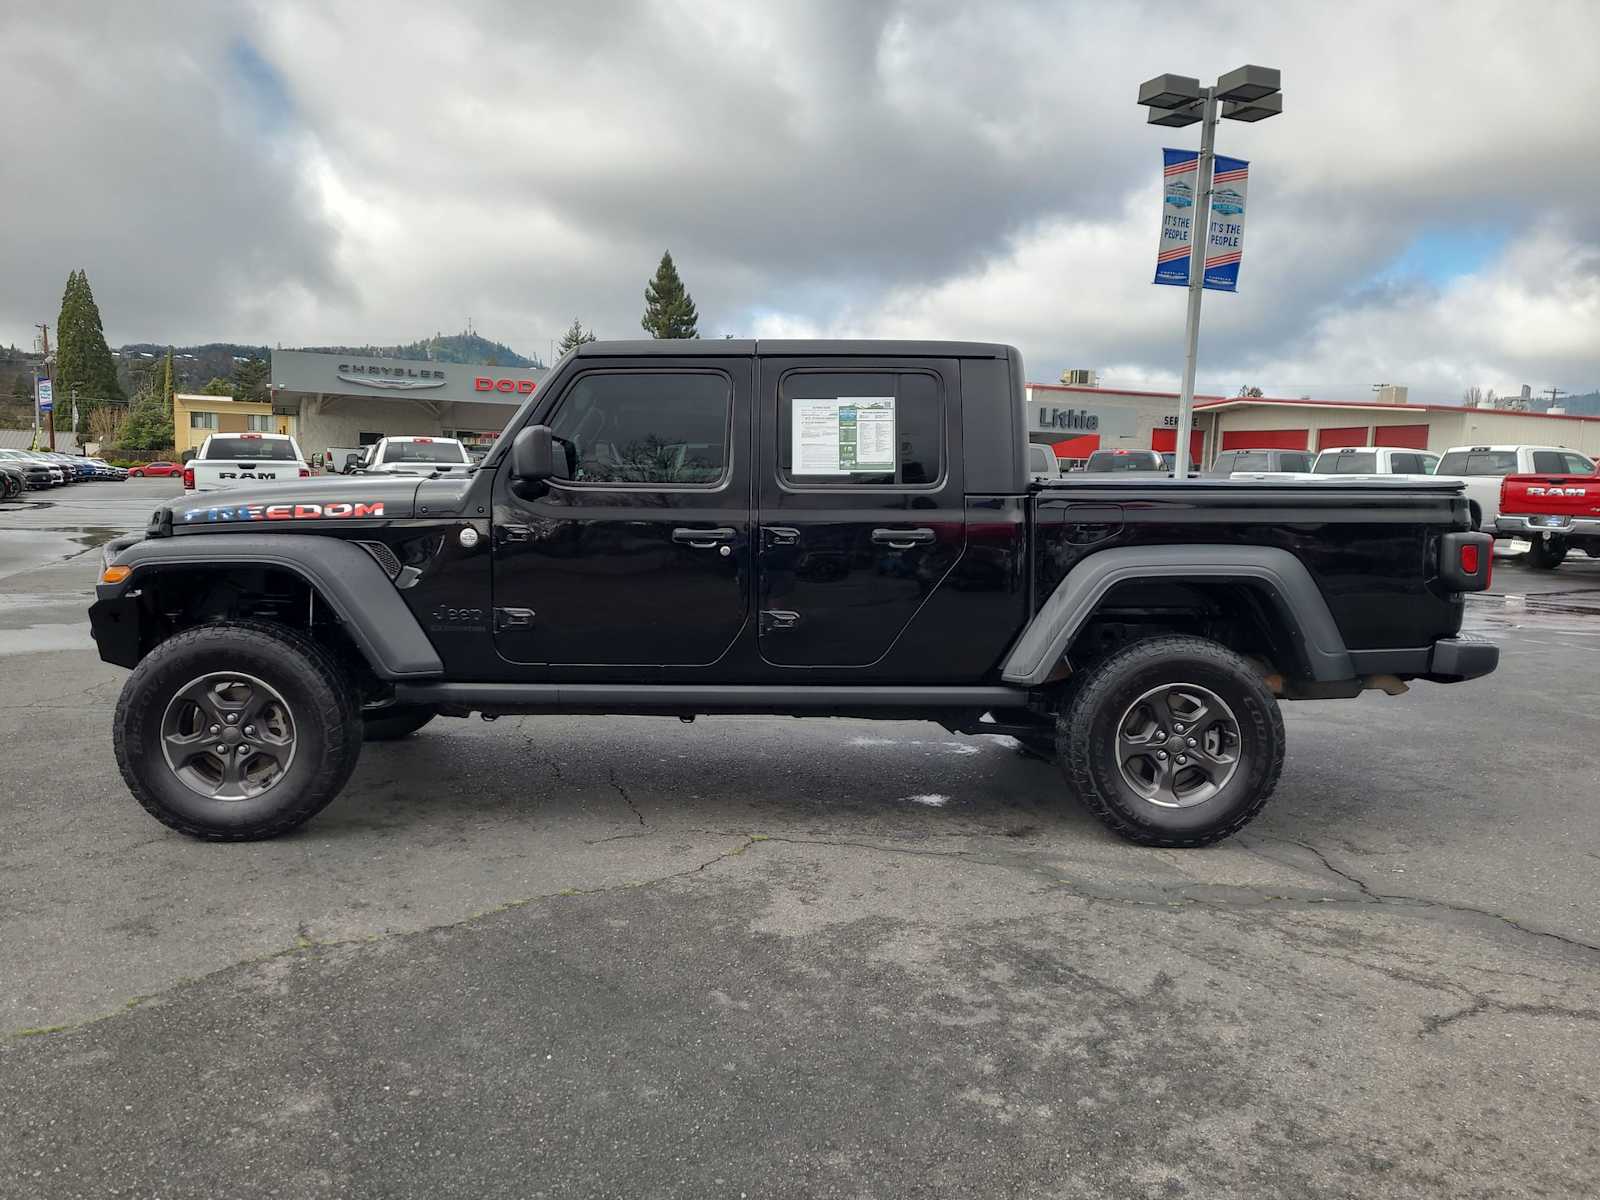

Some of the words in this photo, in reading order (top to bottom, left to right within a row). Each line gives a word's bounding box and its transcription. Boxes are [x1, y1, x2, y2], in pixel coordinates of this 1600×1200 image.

[1164, 215, 1177, 226] IT'S
[1178, 217, 1190, 228] THE
[1211, 221, 1224, 233] IT'S
[1226, 223, 1241, 235] THE
[1164, 228, 1188, 241] PEOPLE
[1210, 234, 1239, 247] PEOPLE
[338, 363, 445, 380] CHRYSLER
[1039, 407, 1099, 431] Lithia
[1164, 415, 1199, 427] SERE
[219, 472, 276, 480] RAM
[1526, 487, 1586, 497] RAM
[184, 502, 385, 521] FREEDOM
